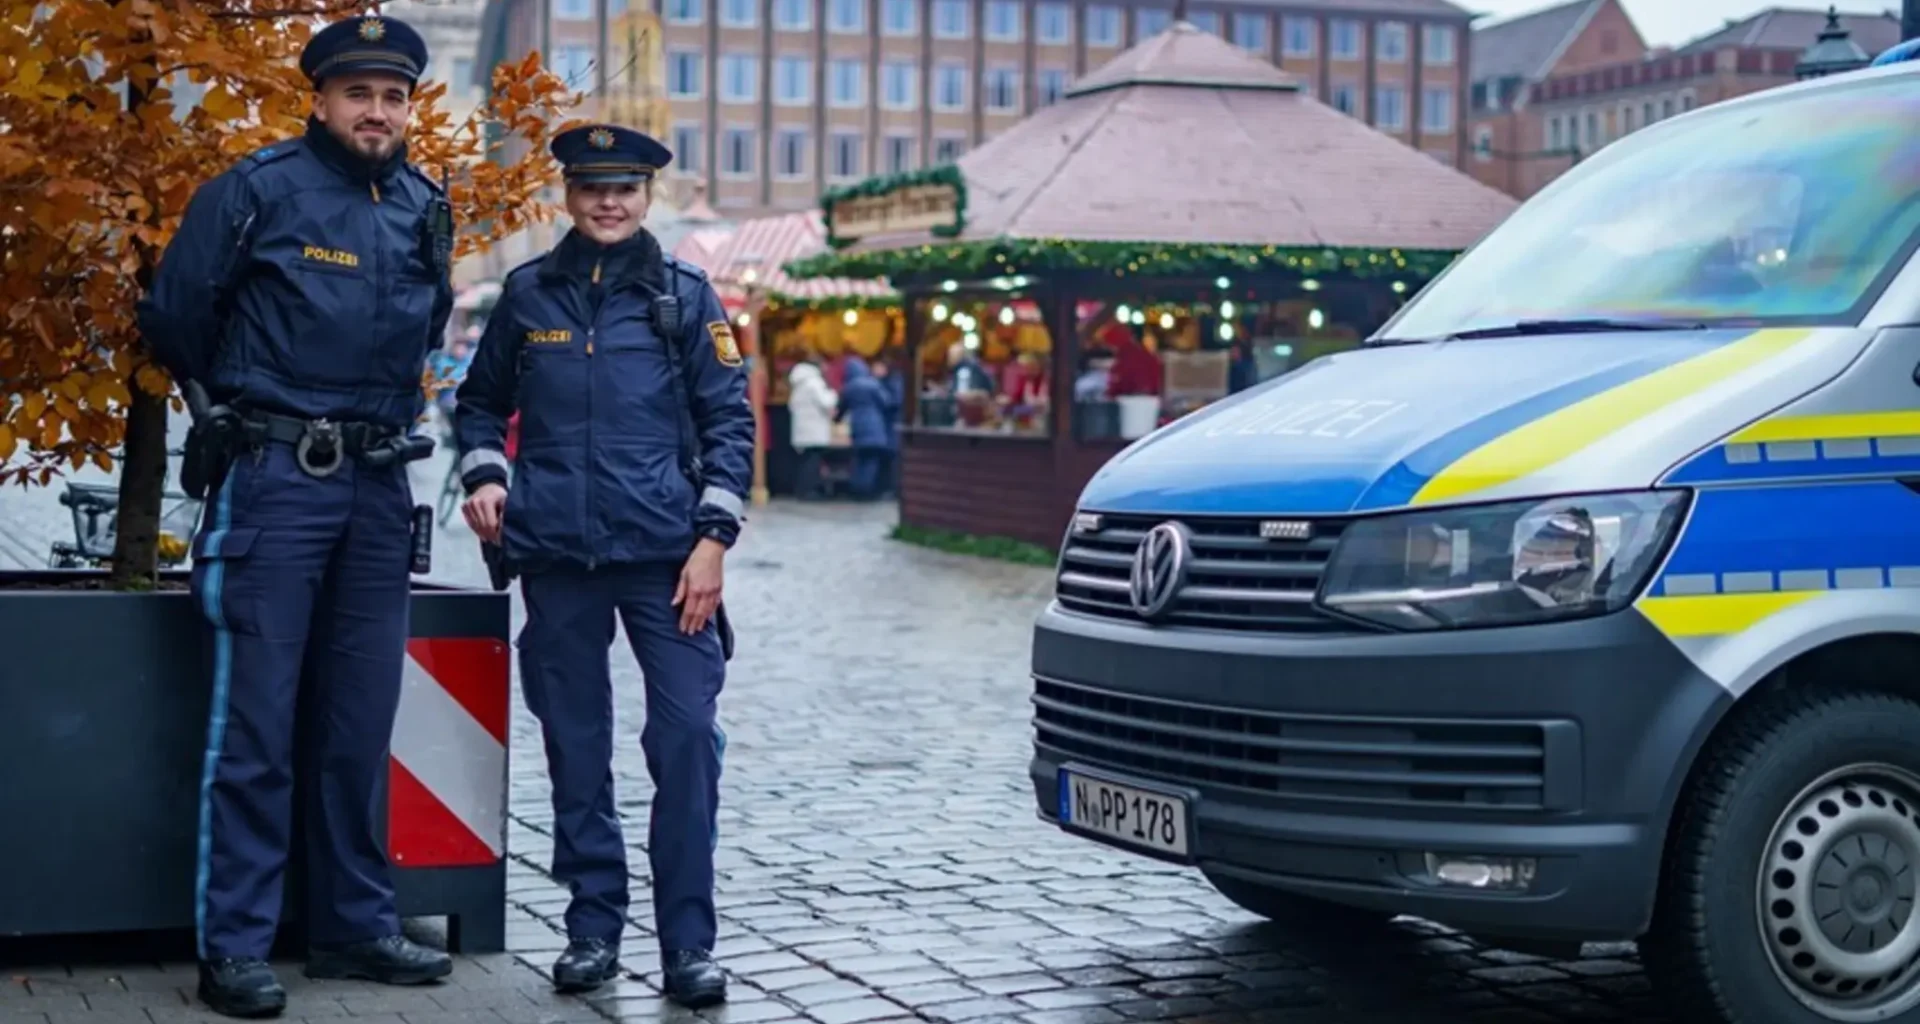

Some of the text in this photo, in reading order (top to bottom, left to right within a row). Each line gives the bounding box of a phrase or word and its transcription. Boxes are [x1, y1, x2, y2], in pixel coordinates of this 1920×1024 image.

[303, 245, 358, 267] POLIZEI
[1203, 400, 1409, 439] OLIZEI
[1076, 781, 1089, 822] N
